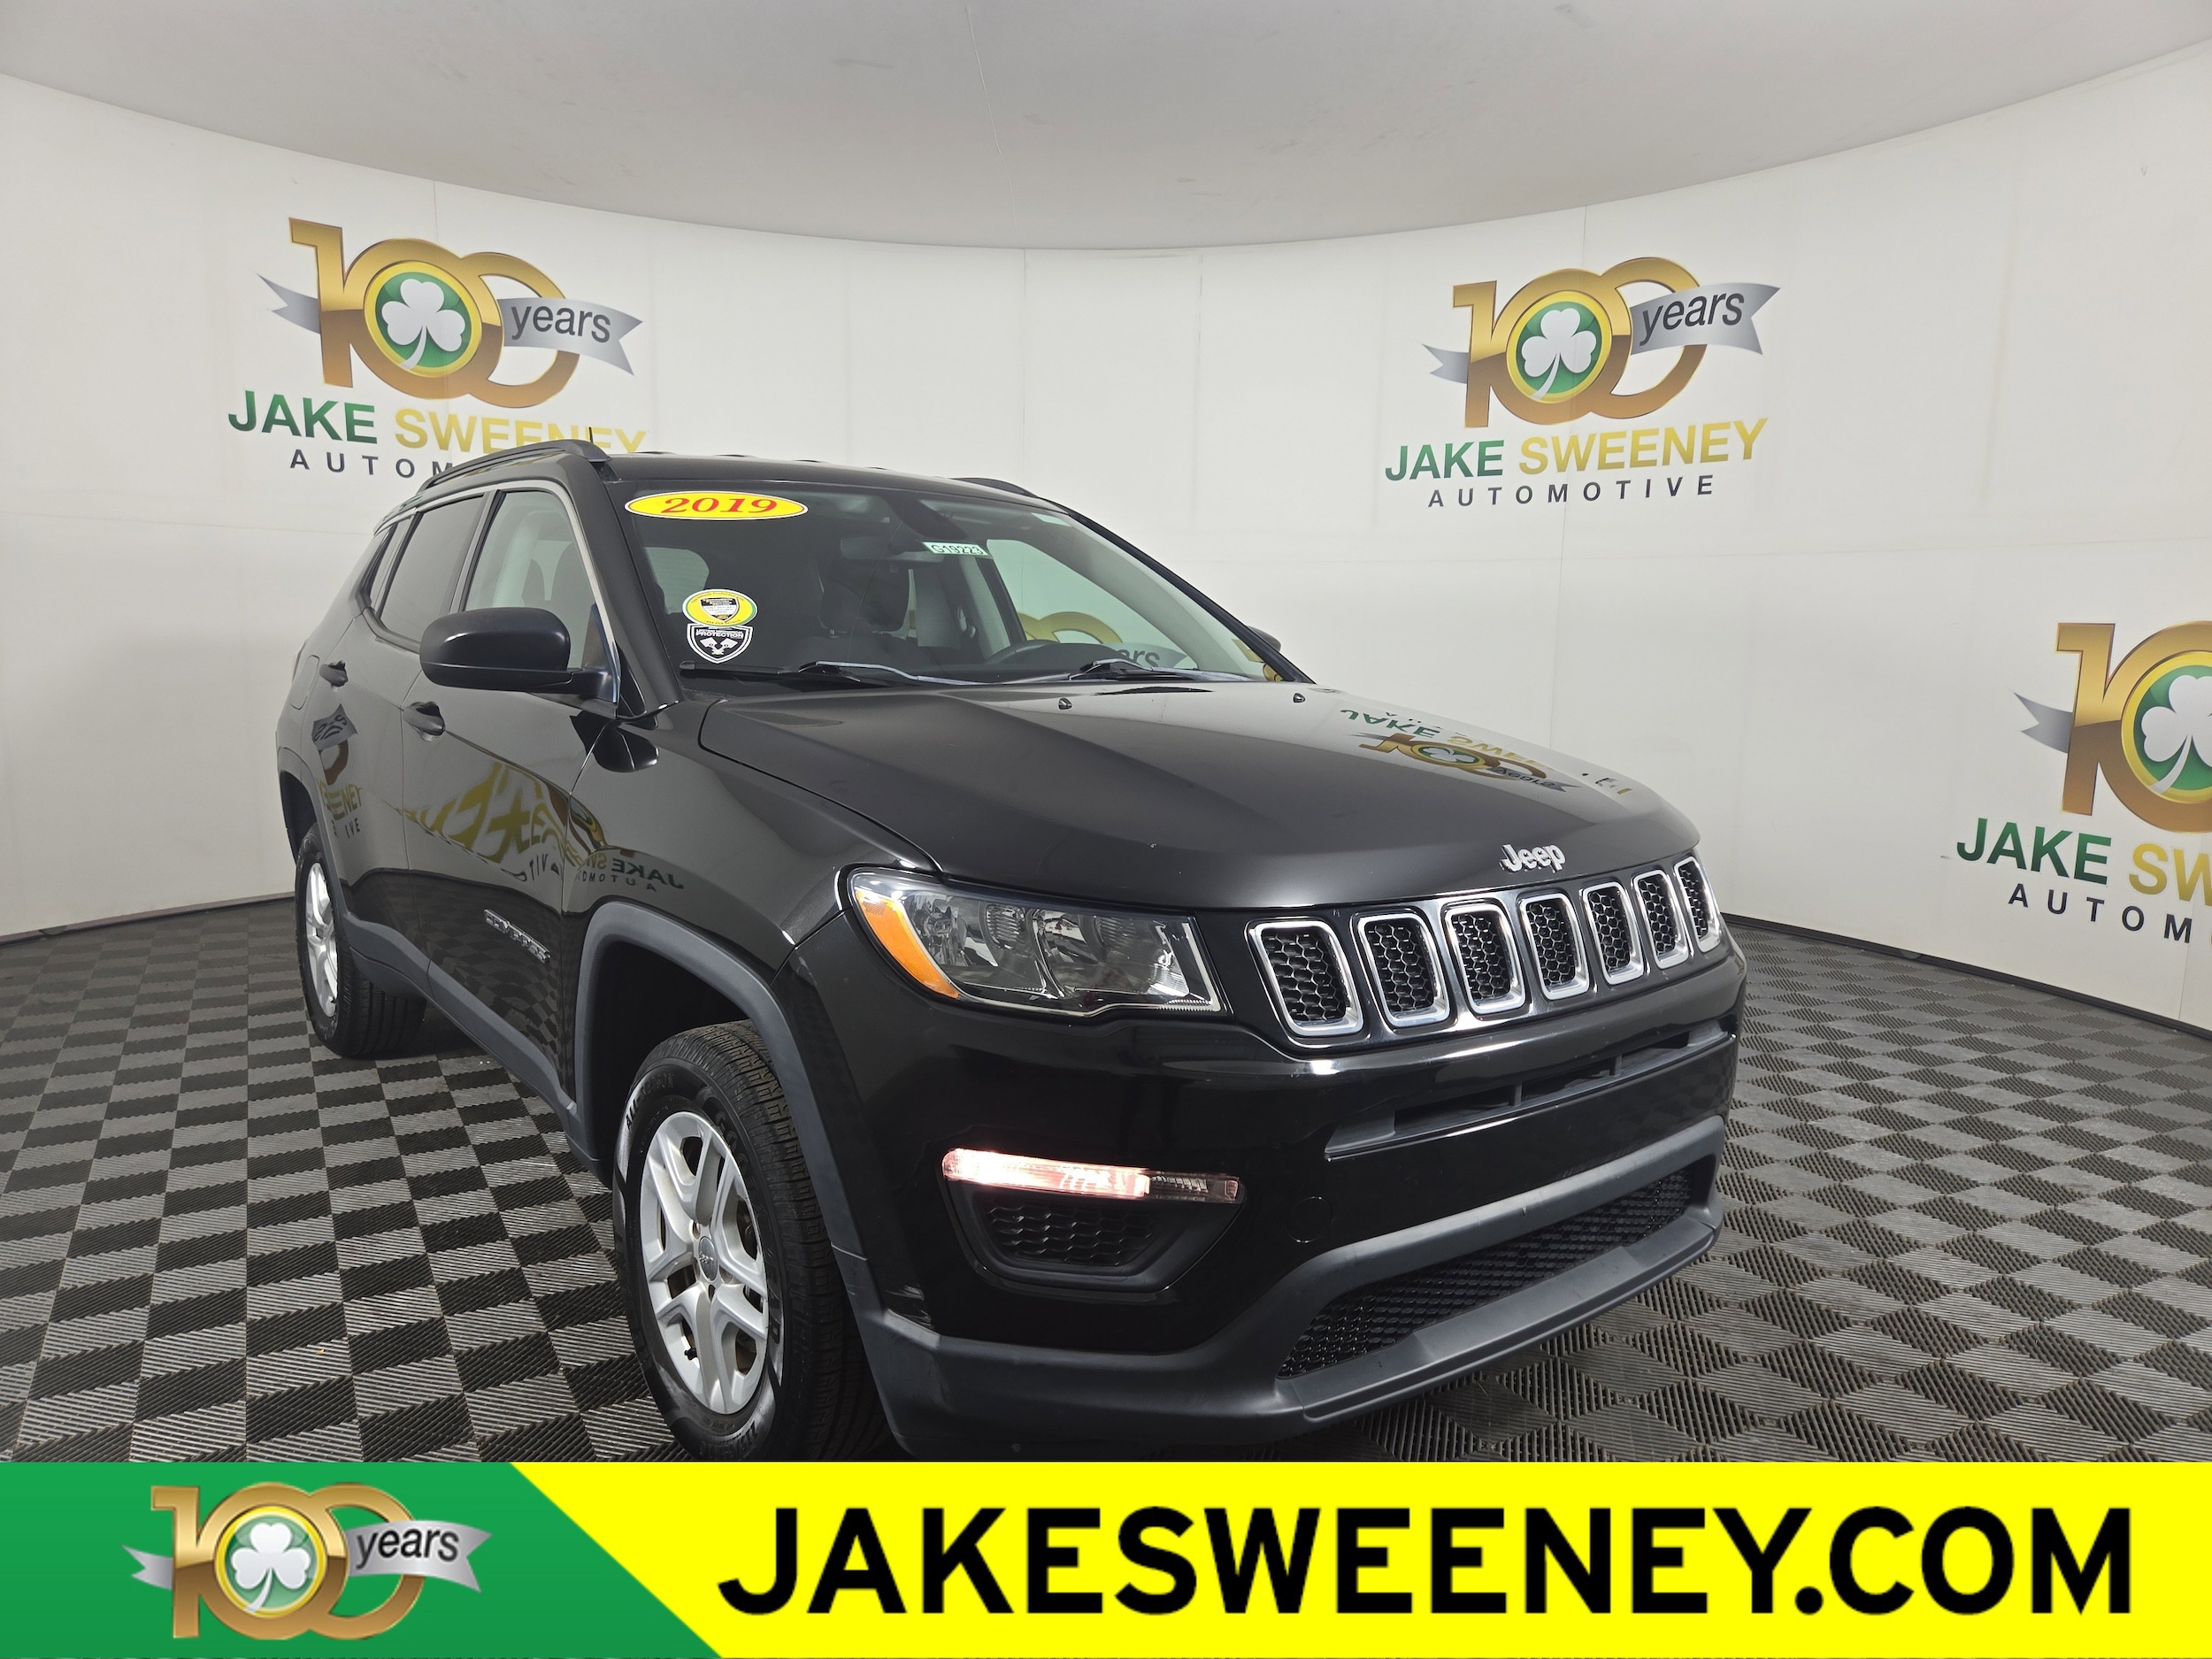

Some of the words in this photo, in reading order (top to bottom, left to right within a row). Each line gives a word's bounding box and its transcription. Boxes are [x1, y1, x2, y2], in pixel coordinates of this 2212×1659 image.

[289, 217, 580, 408] 100
[511, 303, 611, 343] years
[1453, 257, 1708, 428] 100
[1639, 291, 1745, 347] years
[227, 389, 378, 444] JAKE
[1385, 440, 1504, 481] JAKE
[1518, 417, 1768, 476] SWEENEY
[661, 497, 777, 513] 2019
[1427, 474, 1714, 508] AUTOMOTIVE
[1500, 844, 1565, 873] Jeep
[1956, 818, 2112, 885] JAKE
[2008, 883, 2212, 947] AUTOM
